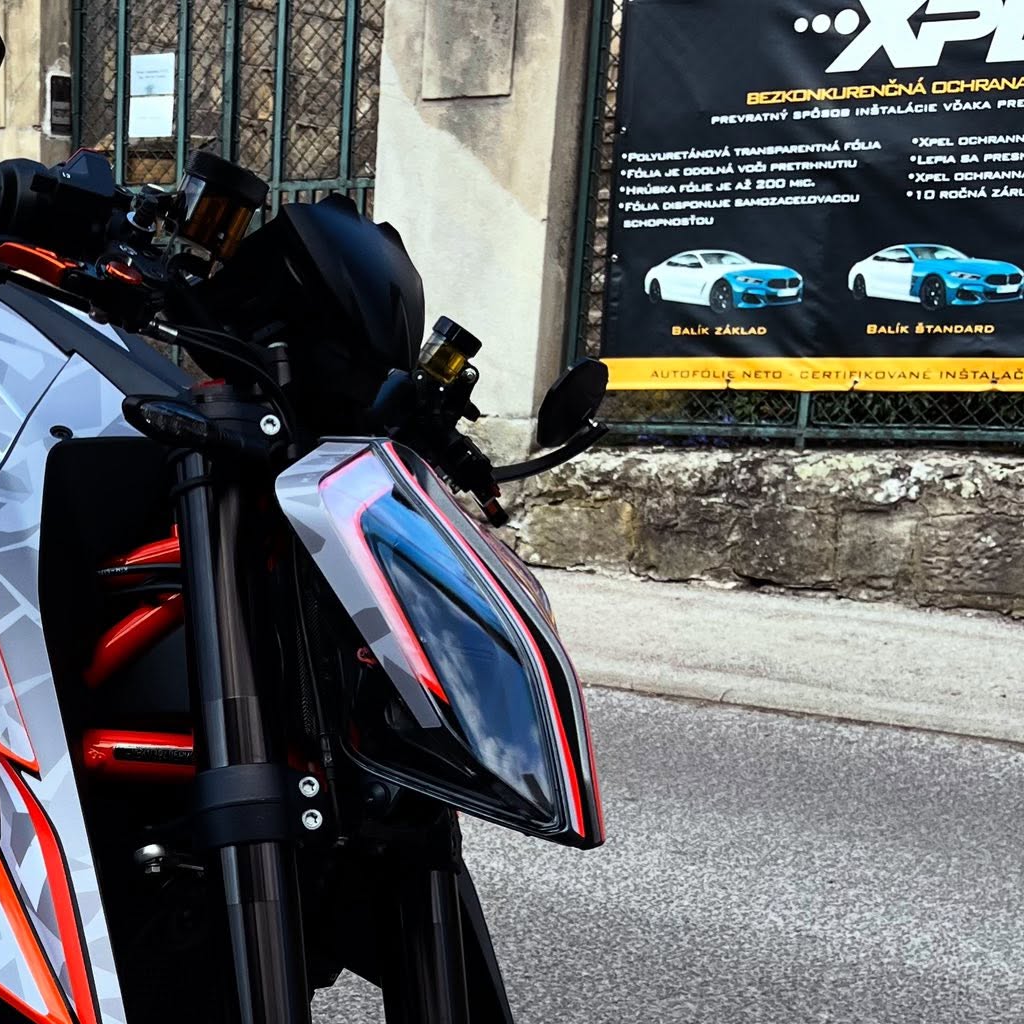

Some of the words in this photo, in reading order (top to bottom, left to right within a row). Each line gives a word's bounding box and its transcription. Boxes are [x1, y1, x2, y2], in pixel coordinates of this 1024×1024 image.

[747, 77, 926, 105] BEZKONKURENČNÁ
[711, 109, 788, 125] PREVRATNÝ
[793, 106, 850, 120] SPÔSOB
[856, 102, 937, 117] INŠTALÁCIE
[943, 99, 992, 111] VĎAKA
[734, 140, 840, 156] TRANSPARENTNÁ
[844, 138, 881, 151] FÓLIA
[918, 137, 954, 147] XPEL
[960, 154, 979, 163] SA
[627, 167, 661, 179] FÓLIA
[665, 168, 680, 177] JE
[683, 162, 734, 176] ODOLNÁ
[738, 161, 767, 173] VOČI
[770, 160, 857, 172] PRETRHNUTIU
[914, 172, 950, 182] XPEL
[679, 181, 713, 193] FÓLIE
[716, 182, 731, 191] JE
[735, 179, 752, 190] AŽ
[756, 179, 786, 190] 200
[789, 179, 815, 188] MIC.
[916, 190, 935, 200] 10
[939, 186, 988, 199] ROČNÁ
[625, 200, 659, 212] FÓLIA
[663, 199, 730, 211] DISPONUJE
[623, 214, 714, 228] SCHOPNOSŤOU
[671, 324, 709, 336] BALÍK
[714, 324, 767, 336] ZÁKLAD
[866, 323, 909, 334] BALÍK
[915, 322, 995, 334] ŠTANDARD
[742, 370, 782, 380] NETO
[800, 368, 931, 380] CERTIFIKOVANÉ
